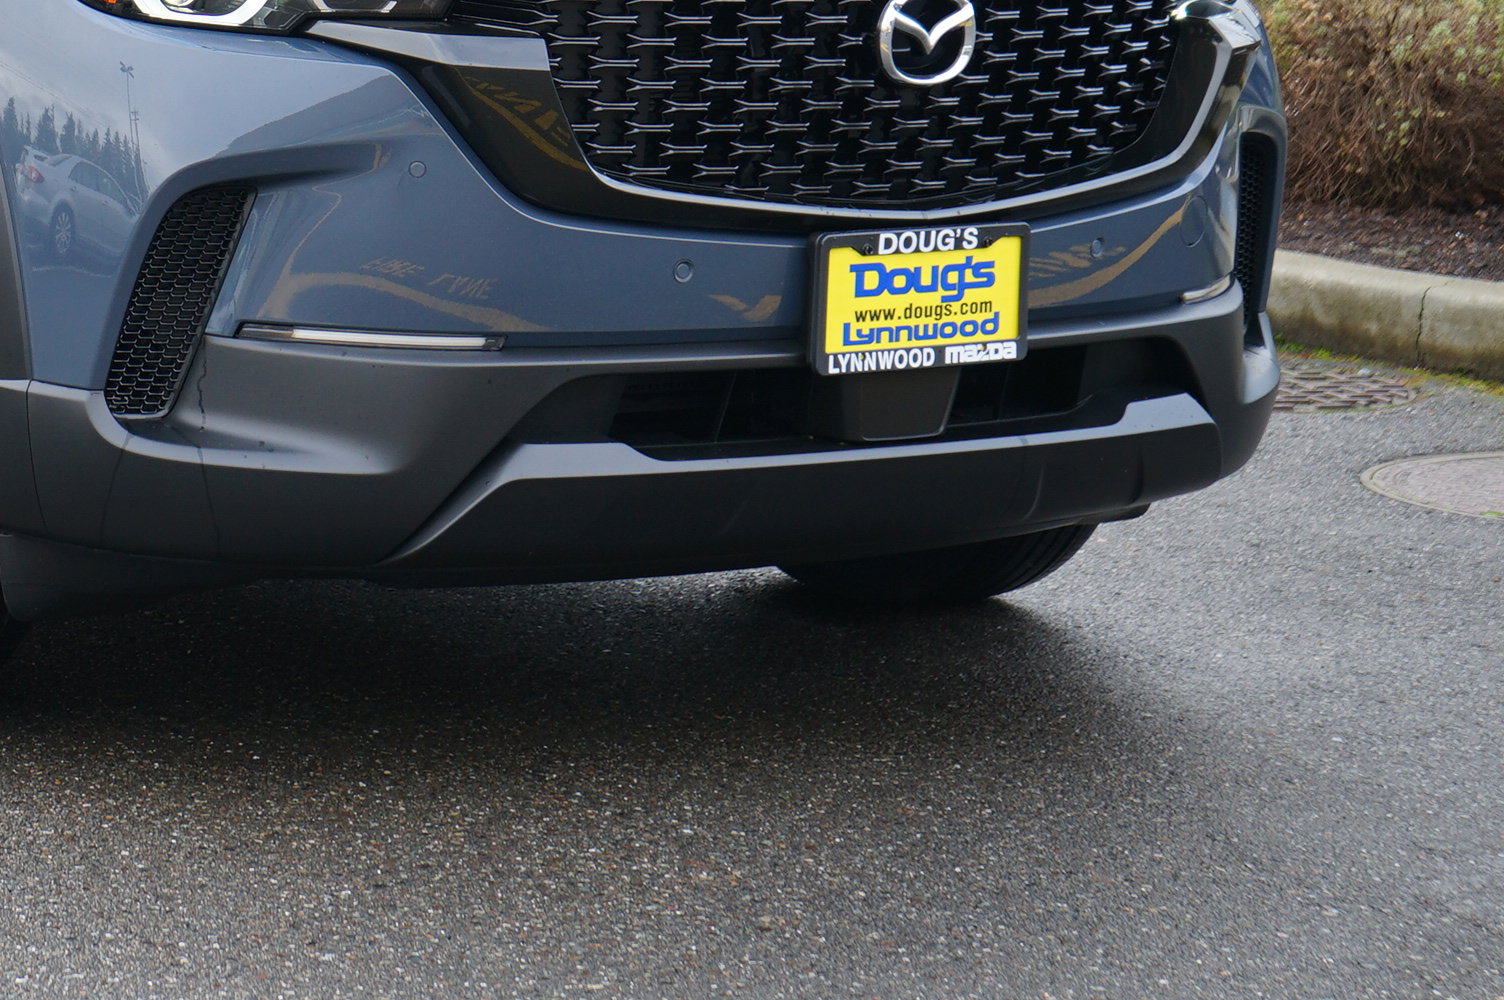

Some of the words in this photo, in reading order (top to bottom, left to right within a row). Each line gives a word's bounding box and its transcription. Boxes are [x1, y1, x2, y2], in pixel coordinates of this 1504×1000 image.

[878, 227, 979, 255] DOUG'S
[849, 255, 996, 304] Doug's
[854, 300, 993, 323] www.dougs.com
[842, 311, 1000, 346] Lynnwood
[828, 347, 935, 375] LYNNWOOD
